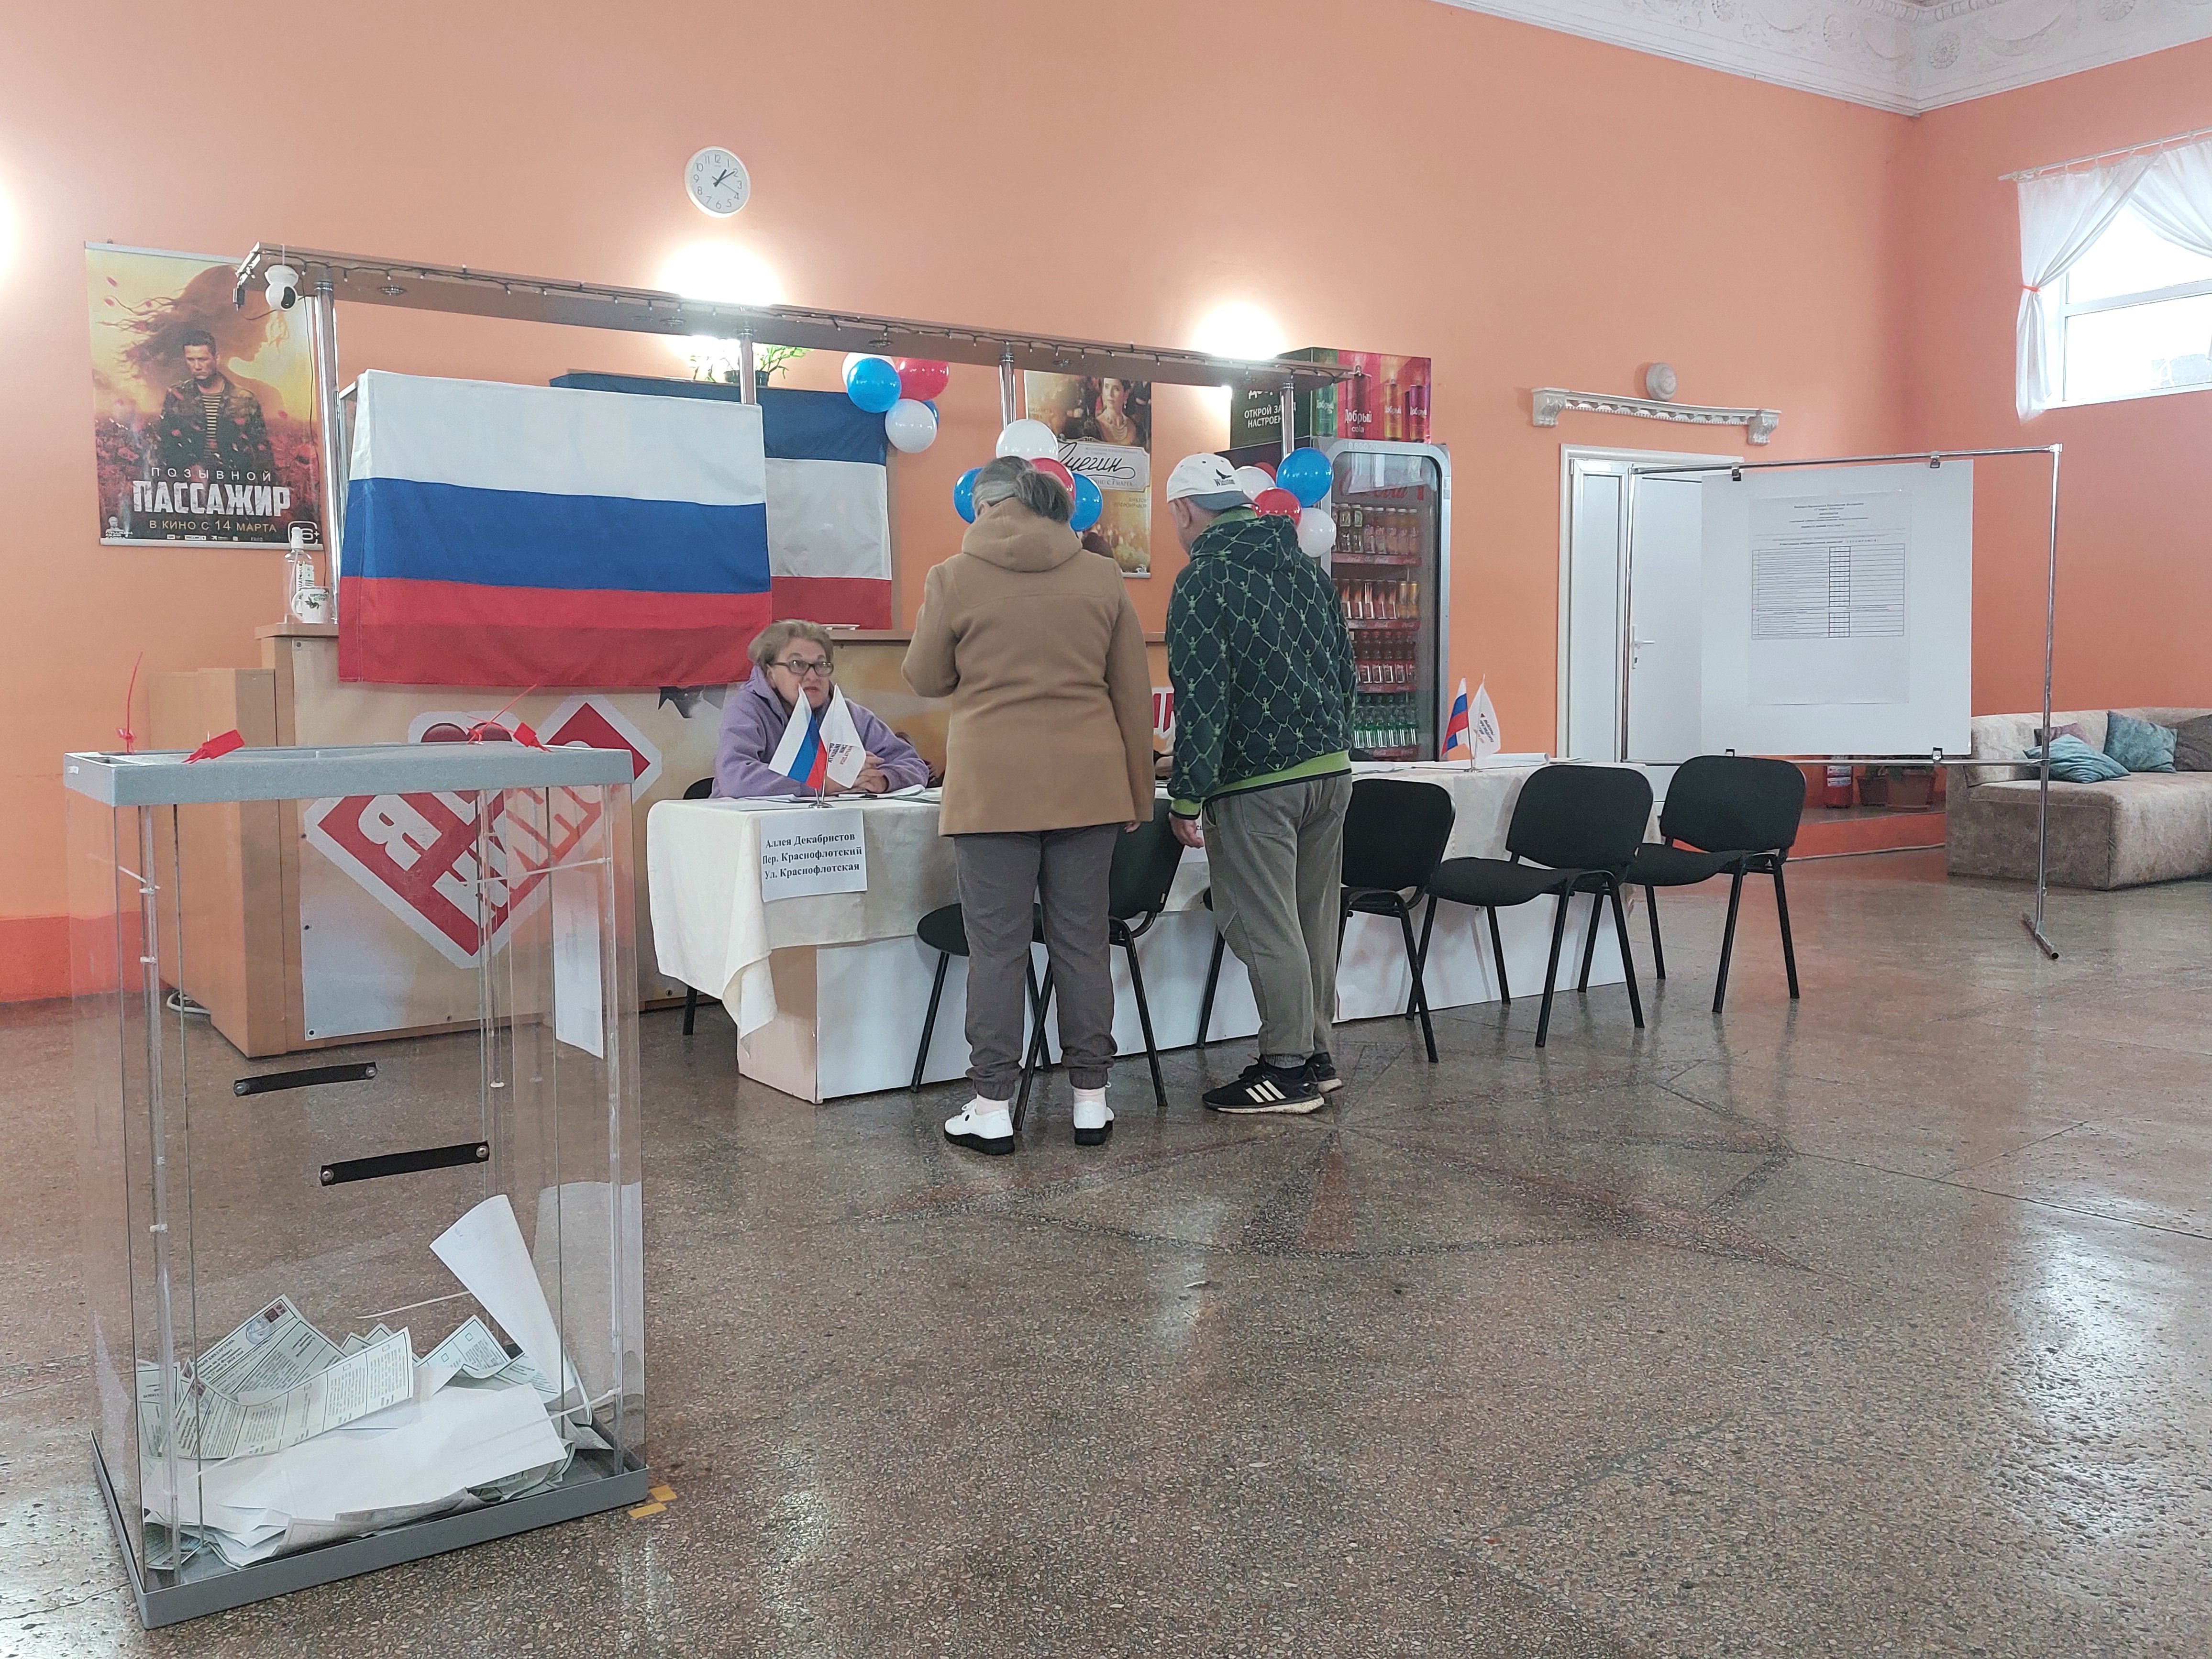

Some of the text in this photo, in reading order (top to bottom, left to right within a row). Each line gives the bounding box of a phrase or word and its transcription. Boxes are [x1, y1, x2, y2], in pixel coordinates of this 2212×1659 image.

[704, 155, 710, 165] 11
[714, 154, 721, 163] 12
[696, 163, 703, 172] 10
[733, 168, 738, 177] 2
[694, 174, 699, 183] 9
[737, 180, 742, 189] 3
[697, 186, 703, 195] 8
[706, 196, 712, 204] 7
[716, 200, 721, 209] 6
[726, 199, 732, 208] 5
[1244, 404, 1272, 420] ОТКРОЙ
[1344, 409, 1372, 424] Добрый
[151, 467, 271, 482] ПОЗЫВНОЙ
[132, 480, 291, 517] ПАССАЖИР
[149, 520, 157, 529] В
[162, 520, 196, 530] КИНО
[215, 520, 231, 531] 14
[236, 522, 277, 533] МАРТА
[358, 795, 443, 871] Я
[765, 833, 855, 849] Аллея Декабристов
[763, 846, 863, 865] Пер. Краснофлотский
[764, 863, 860, 880] Ул. Краснофлотская
